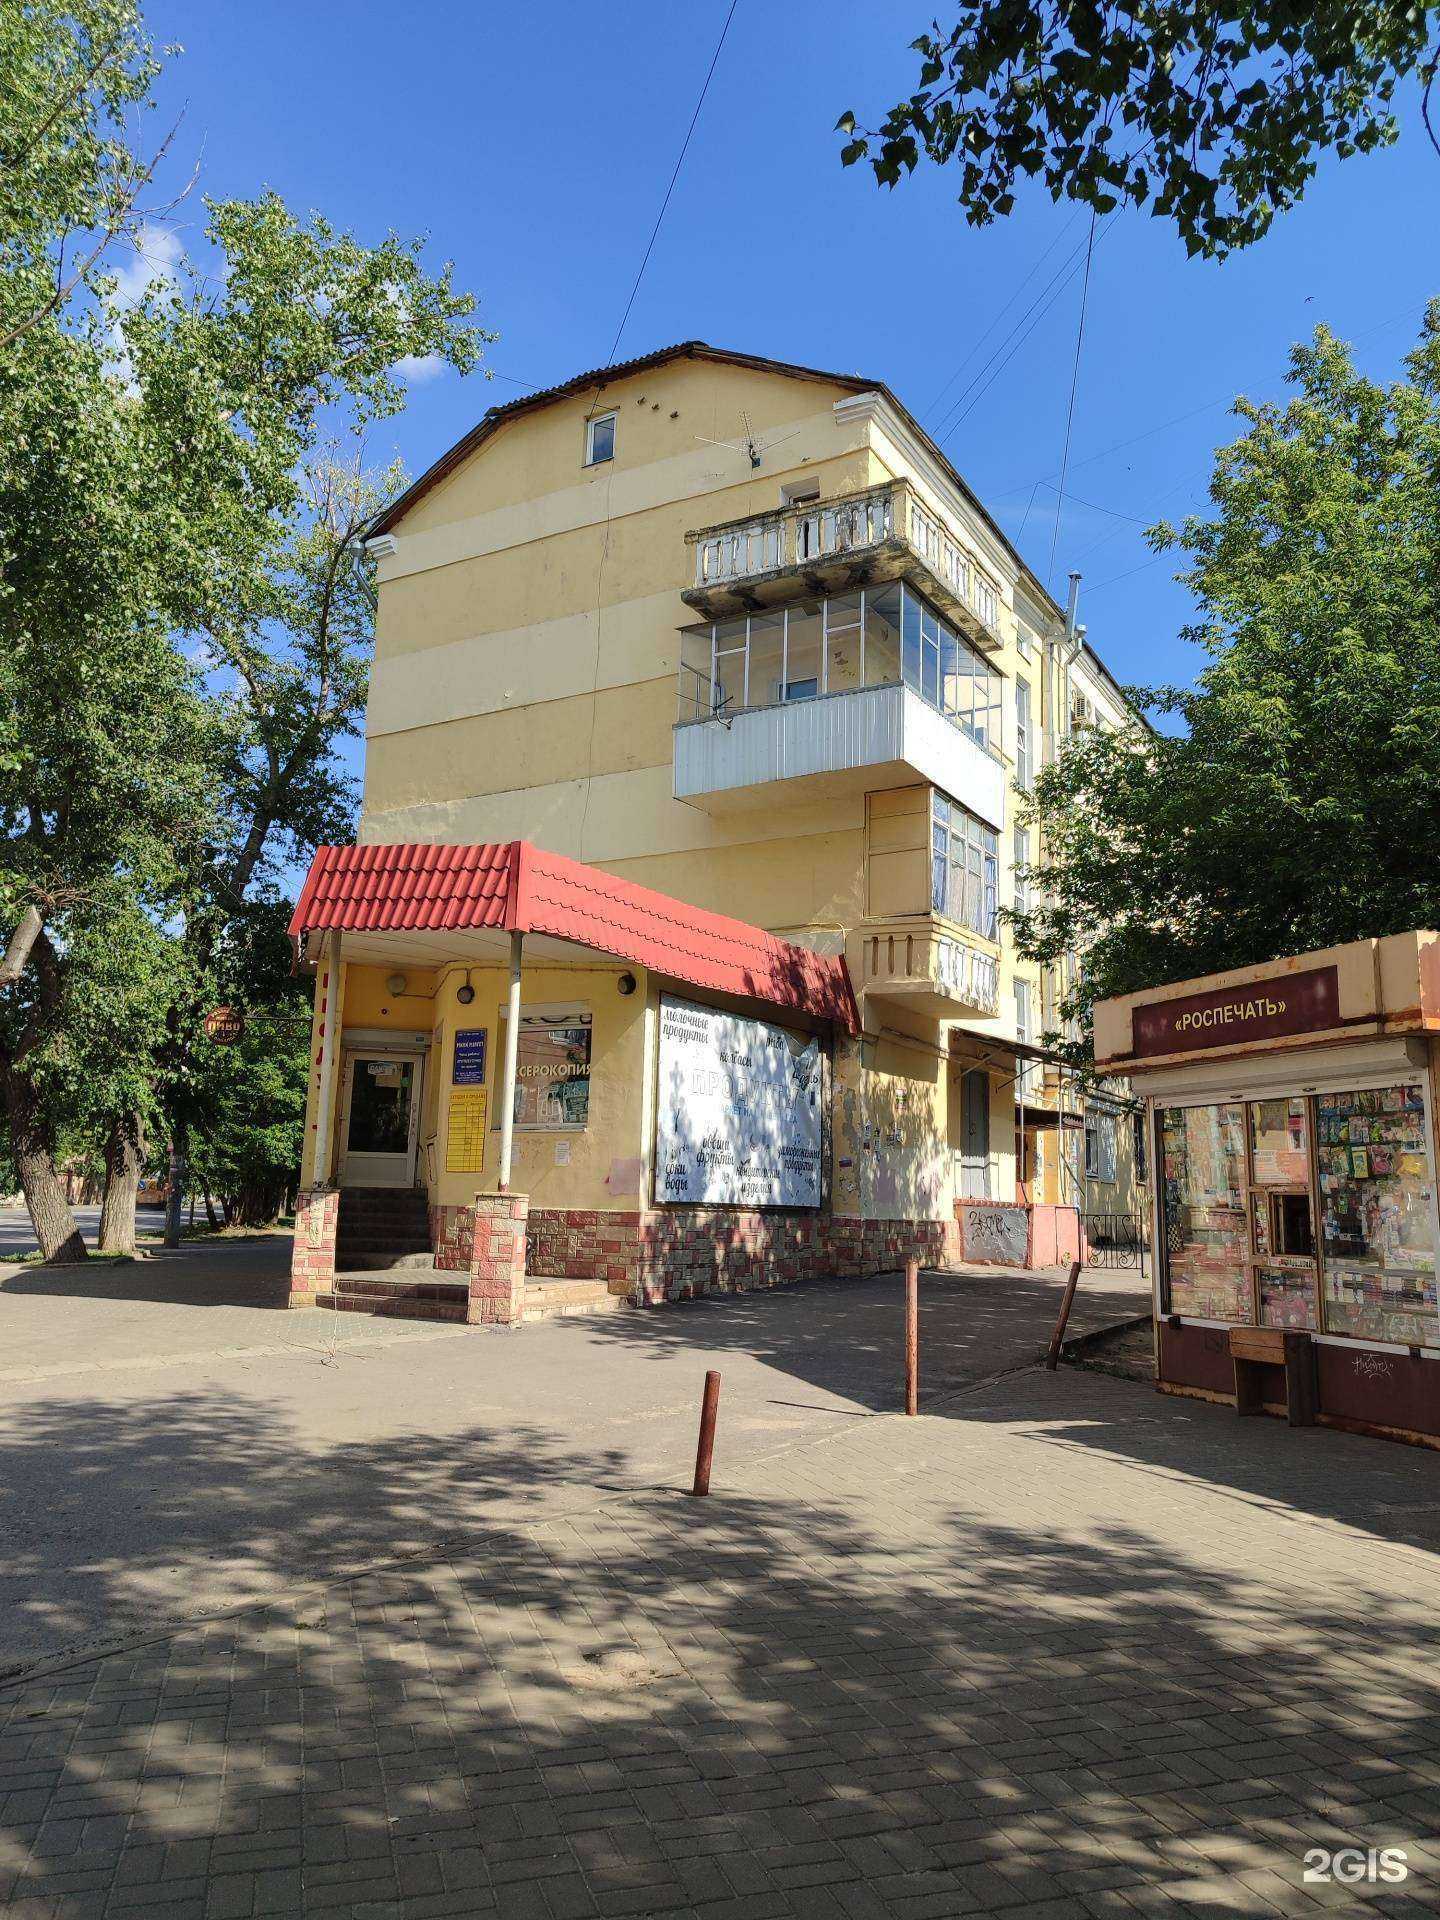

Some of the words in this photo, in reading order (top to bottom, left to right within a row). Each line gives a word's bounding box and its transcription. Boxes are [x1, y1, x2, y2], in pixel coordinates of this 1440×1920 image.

[1175, 998, 1287, 1031] «РОСПЕЧАТЬ»
[207, 1020, 241, 1031] ПИВО
[662, 1023, 709, 1044] продукты
